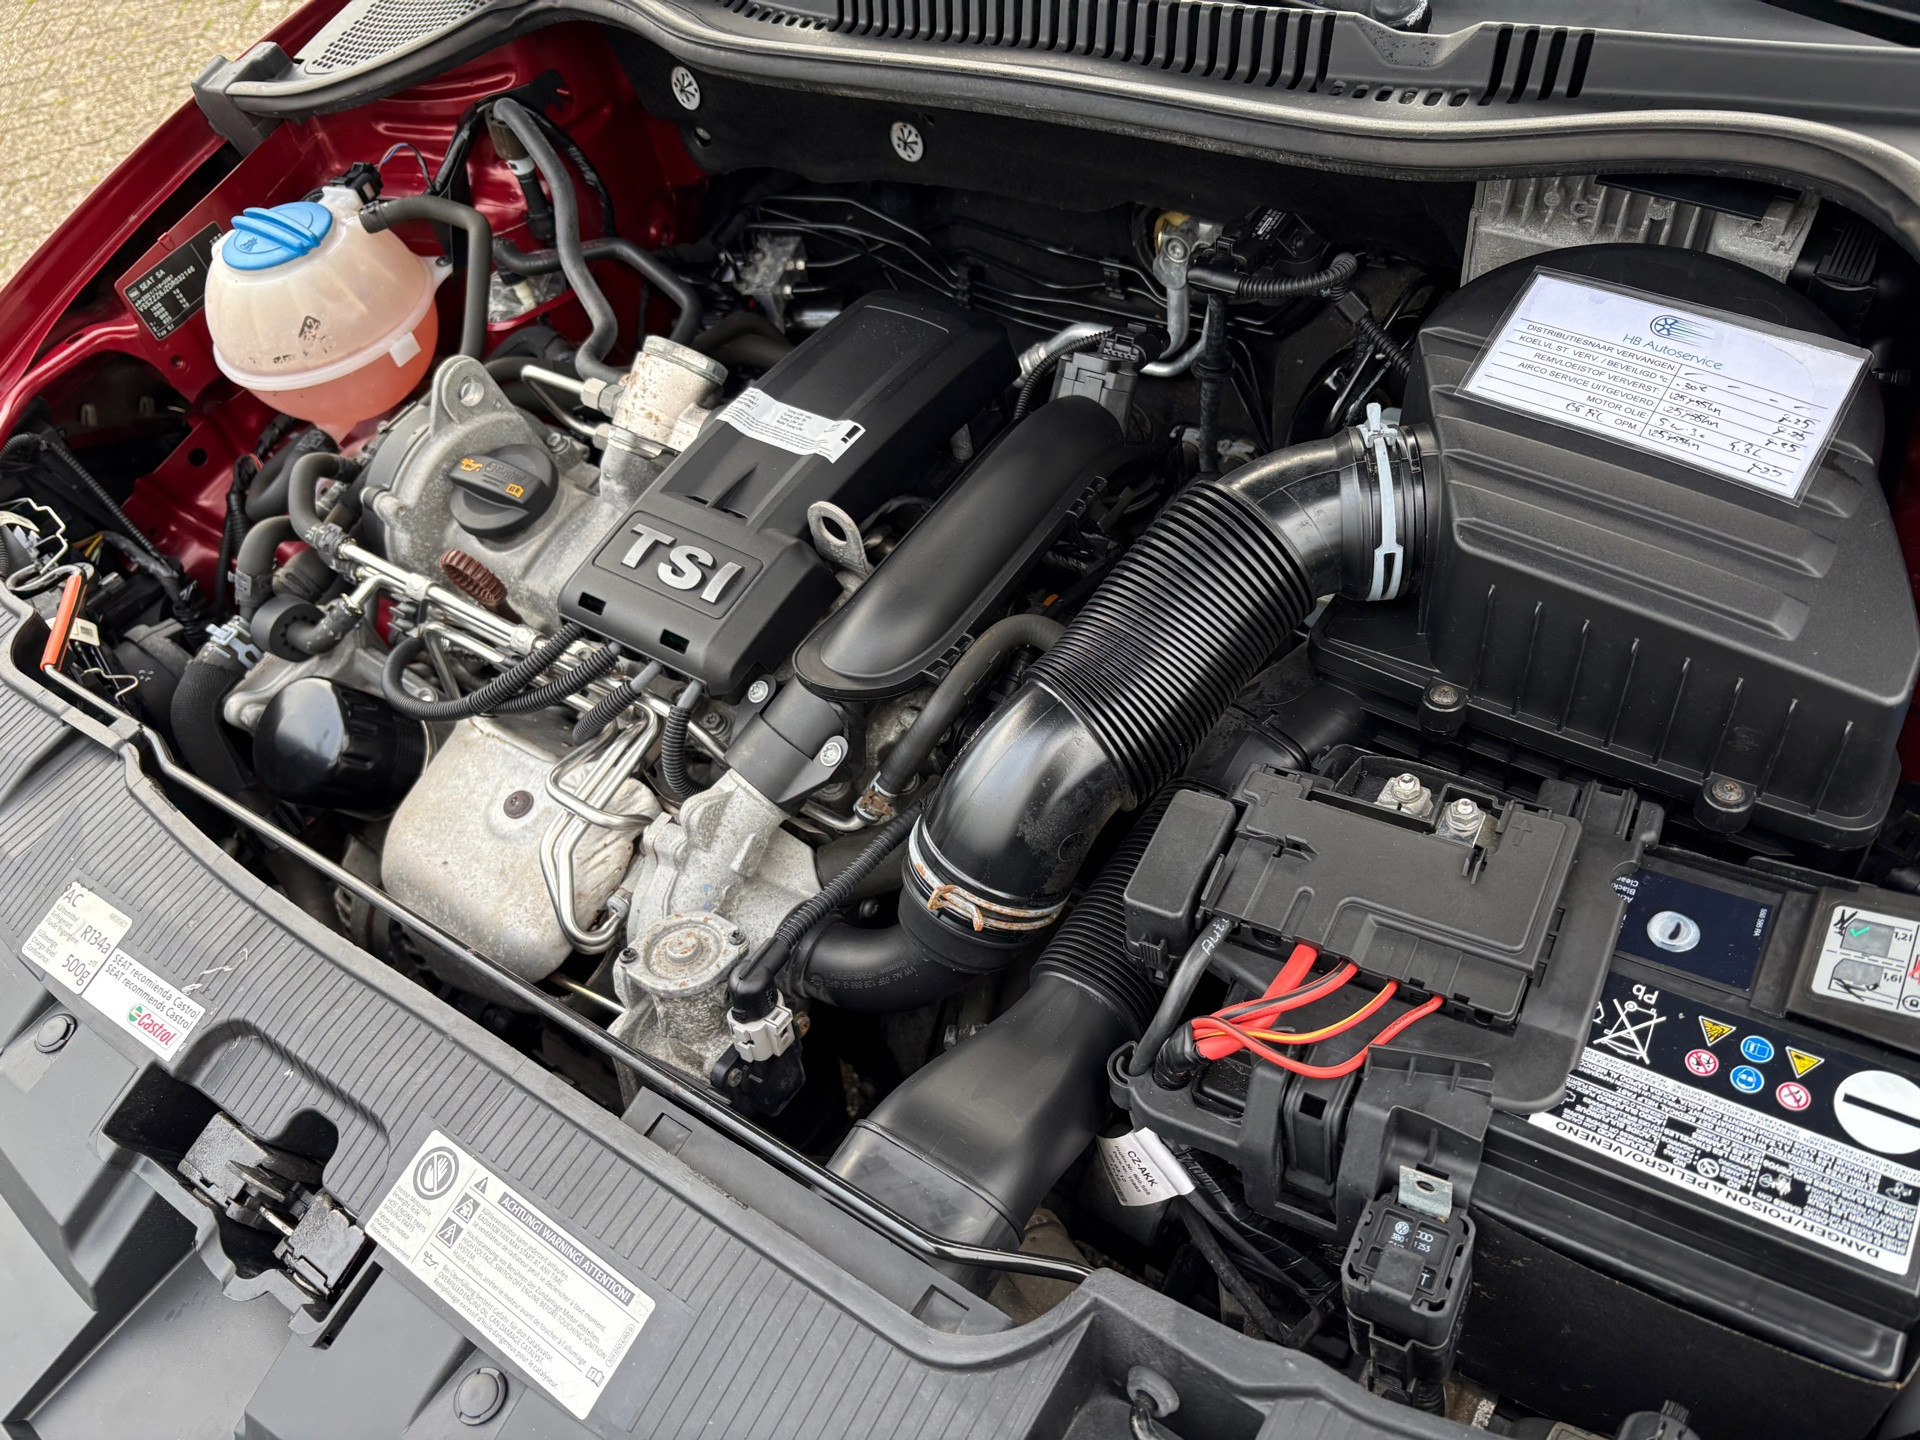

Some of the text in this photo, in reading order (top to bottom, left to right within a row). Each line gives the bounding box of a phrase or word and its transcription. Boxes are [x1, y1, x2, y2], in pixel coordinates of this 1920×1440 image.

[1606, 359, 1657, 378] BEVEILIGD
[1615, 348, 1676, 371] VERVANGEN:
[1622, 333, 1723, 370] HB Autoservice
[1517, 361, 1547, 374] AIRCO
[1548, 370, 1589, 387] SERVICE
[1590, 382, 1655, 406] UITGEVOERD:
[1533, 352, 1605, 377] REMVLOEISTOF
[1607, 373, 1660, 394] VERVERST:
[1586, 395, 1622, 411] MOTOR
[1623, 406, 1649, 419] OLIE:
[620, 523, 744, 604] TSI
[62, 886, 84, 907] AC
[79, 924, 112, 954] R134a
[60, 953, 91, 986] 500g
[112, 953, 201, 1019] SEAT recomienda Castrol
[104, 963, 193, 1030] SEAT recommends Castrol
[1632, 983, 1659, 1005] Pb
[137, 1012, 176, 1045] Castrol
[1126, 1150, 1158, 1187] CZ-AKK
[1554, 1120, 1709, 1189] PELIGRO/VENENO
[477, 1213, 500, 1234] RADIATOR
[518, 1247, 534, 1262] START
[1725, 1189, 1879, 1259] DANGER/POISON
[501, 1196, 631, 1302] ACHTUNG! WARNING! ATTENTION!
[437, 1270, 464, 1296] OVERFILLED
[462, 1291, 481, 1310] ENGINE
[498, 1323, 521, 1345] DAMAGE
[461, 1236, 475, 1250] HIGH
[493, 1262, 513, 1281] SWITCH
[520, 1285, 540, 1304] ENGINE
[538, 1300, 558, 1318] BEFORE
[556, 1314, 584, 1340] TOUCHING
[582, 1336, 607, 1359] IGNITION
